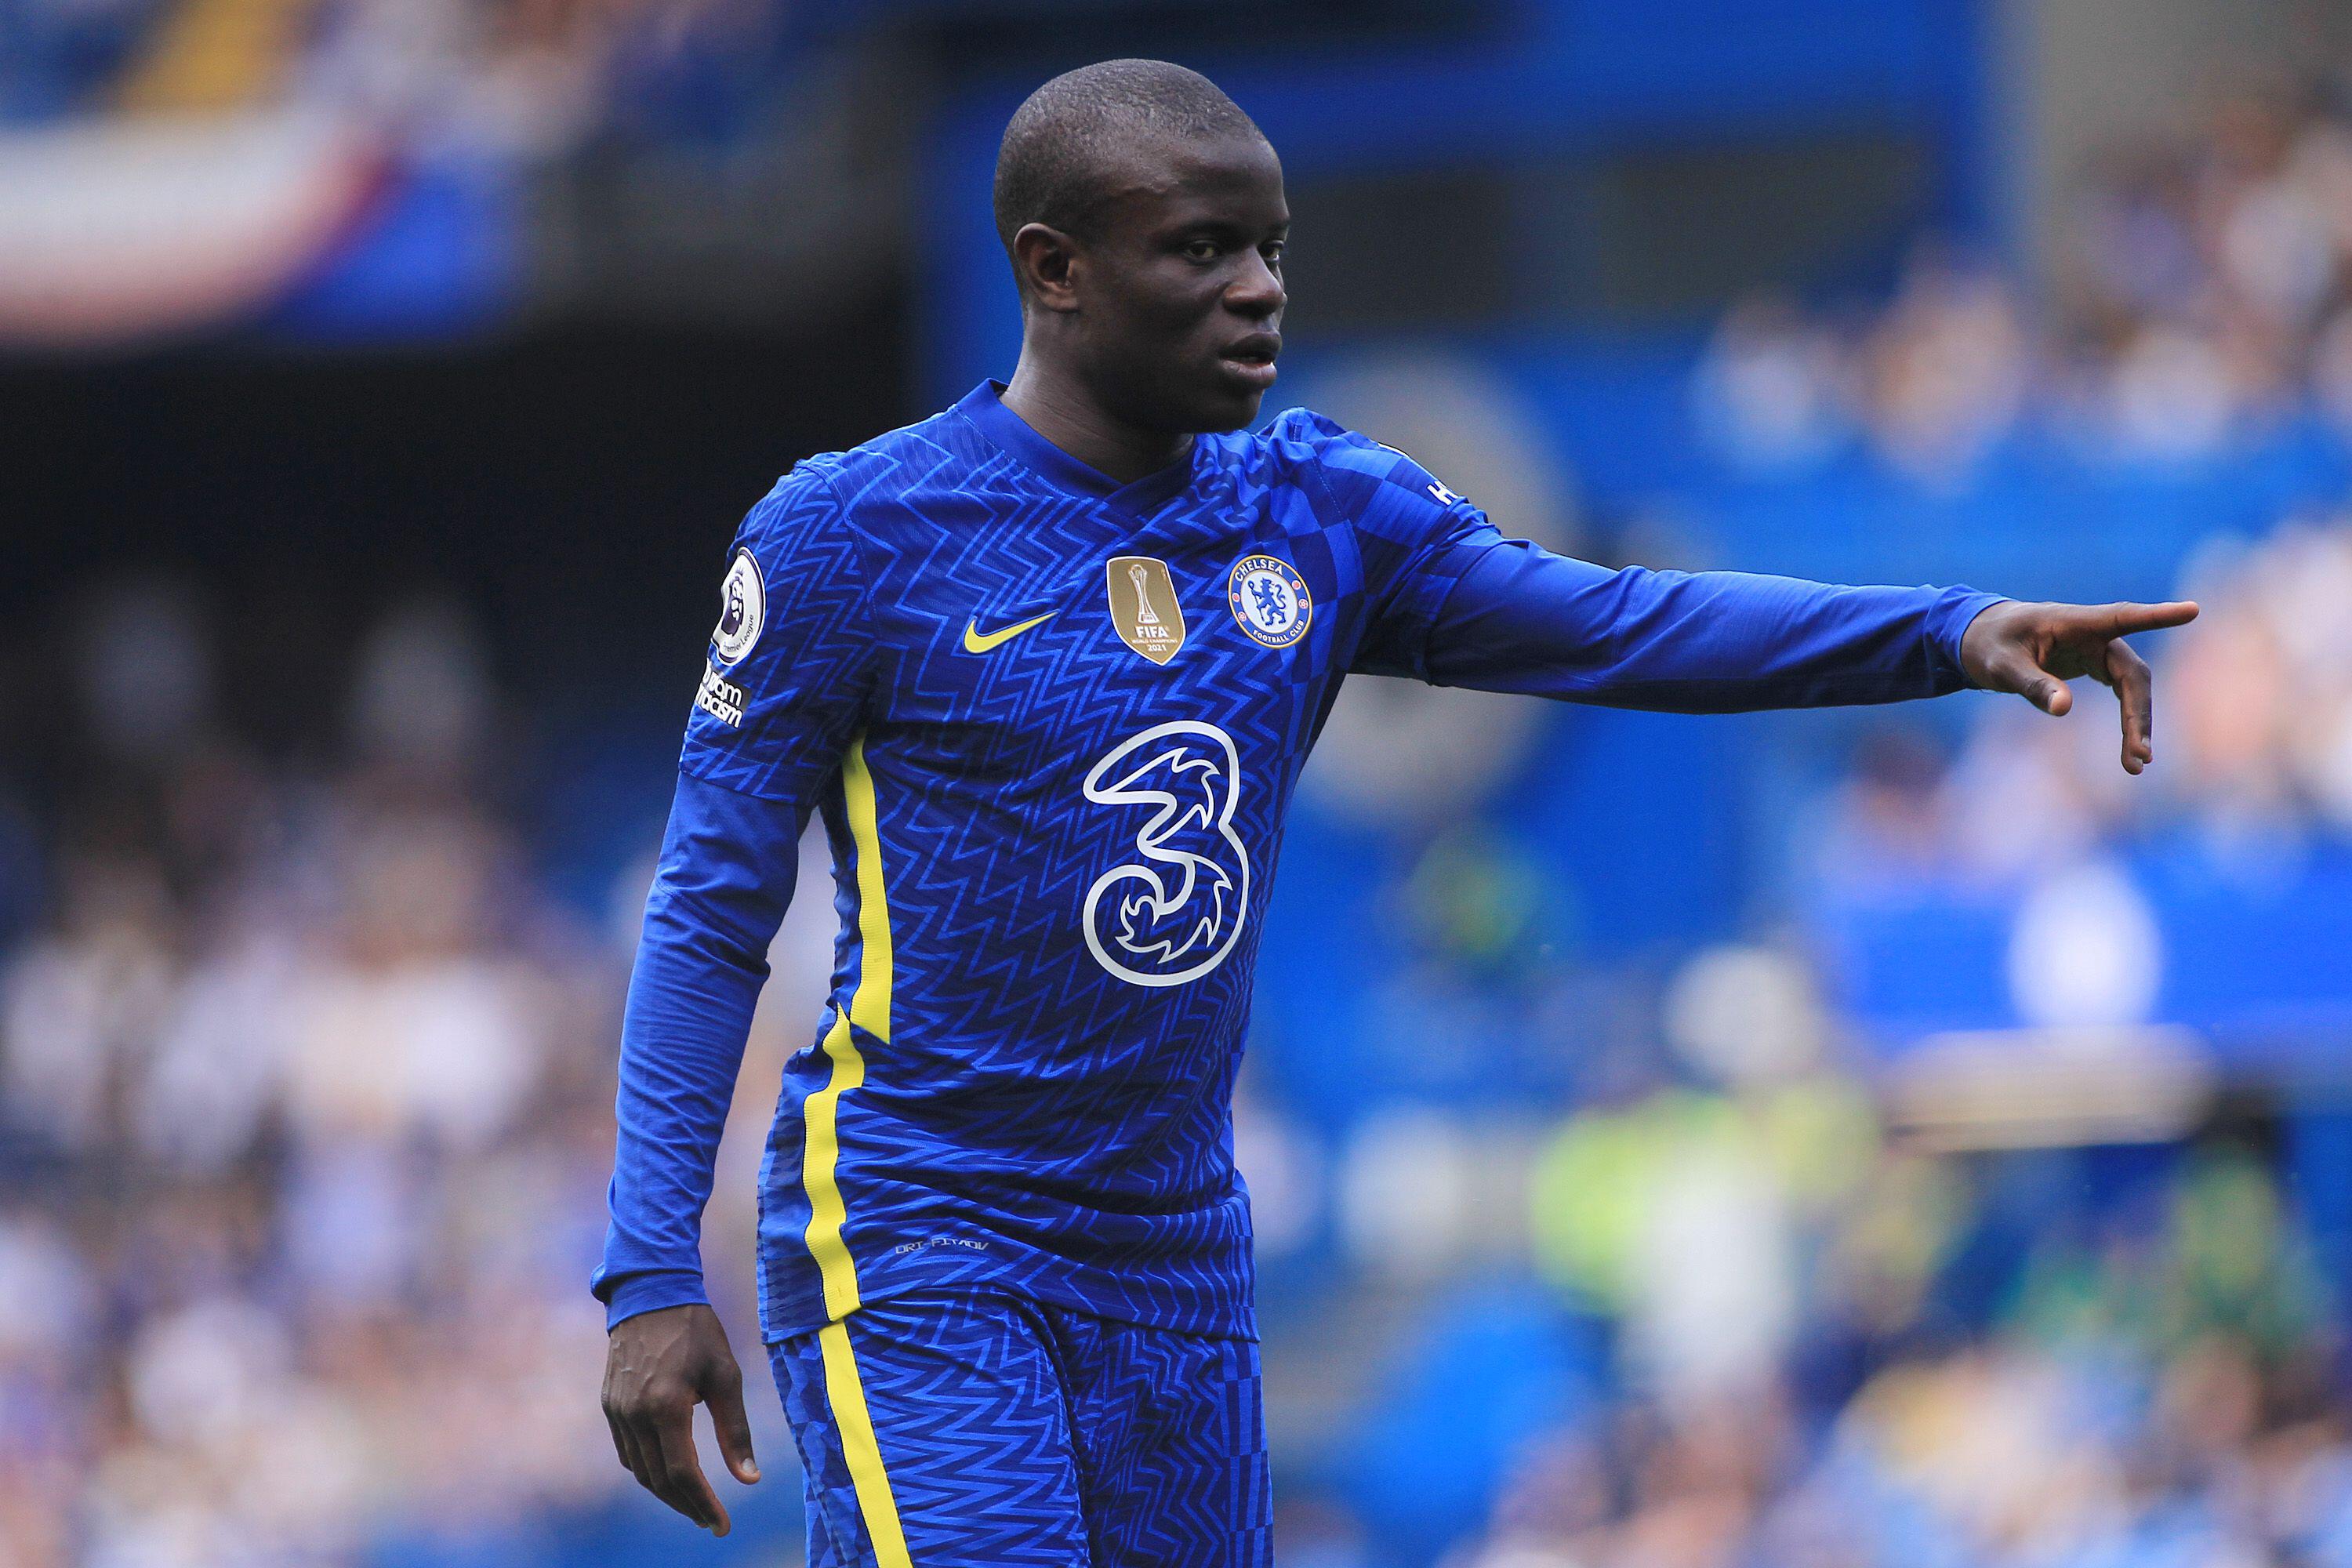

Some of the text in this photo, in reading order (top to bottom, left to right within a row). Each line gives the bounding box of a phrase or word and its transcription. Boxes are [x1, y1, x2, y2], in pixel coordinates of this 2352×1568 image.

[1235, 558, 1283, 582] CHELSEA
[740, 614, 754, 645] League
[1134, 626, 1169, 638] FIFA
[1253, 619, 1305, 643] FOOTBALL CLUB
[1083, 720, 1250, 987] 3
